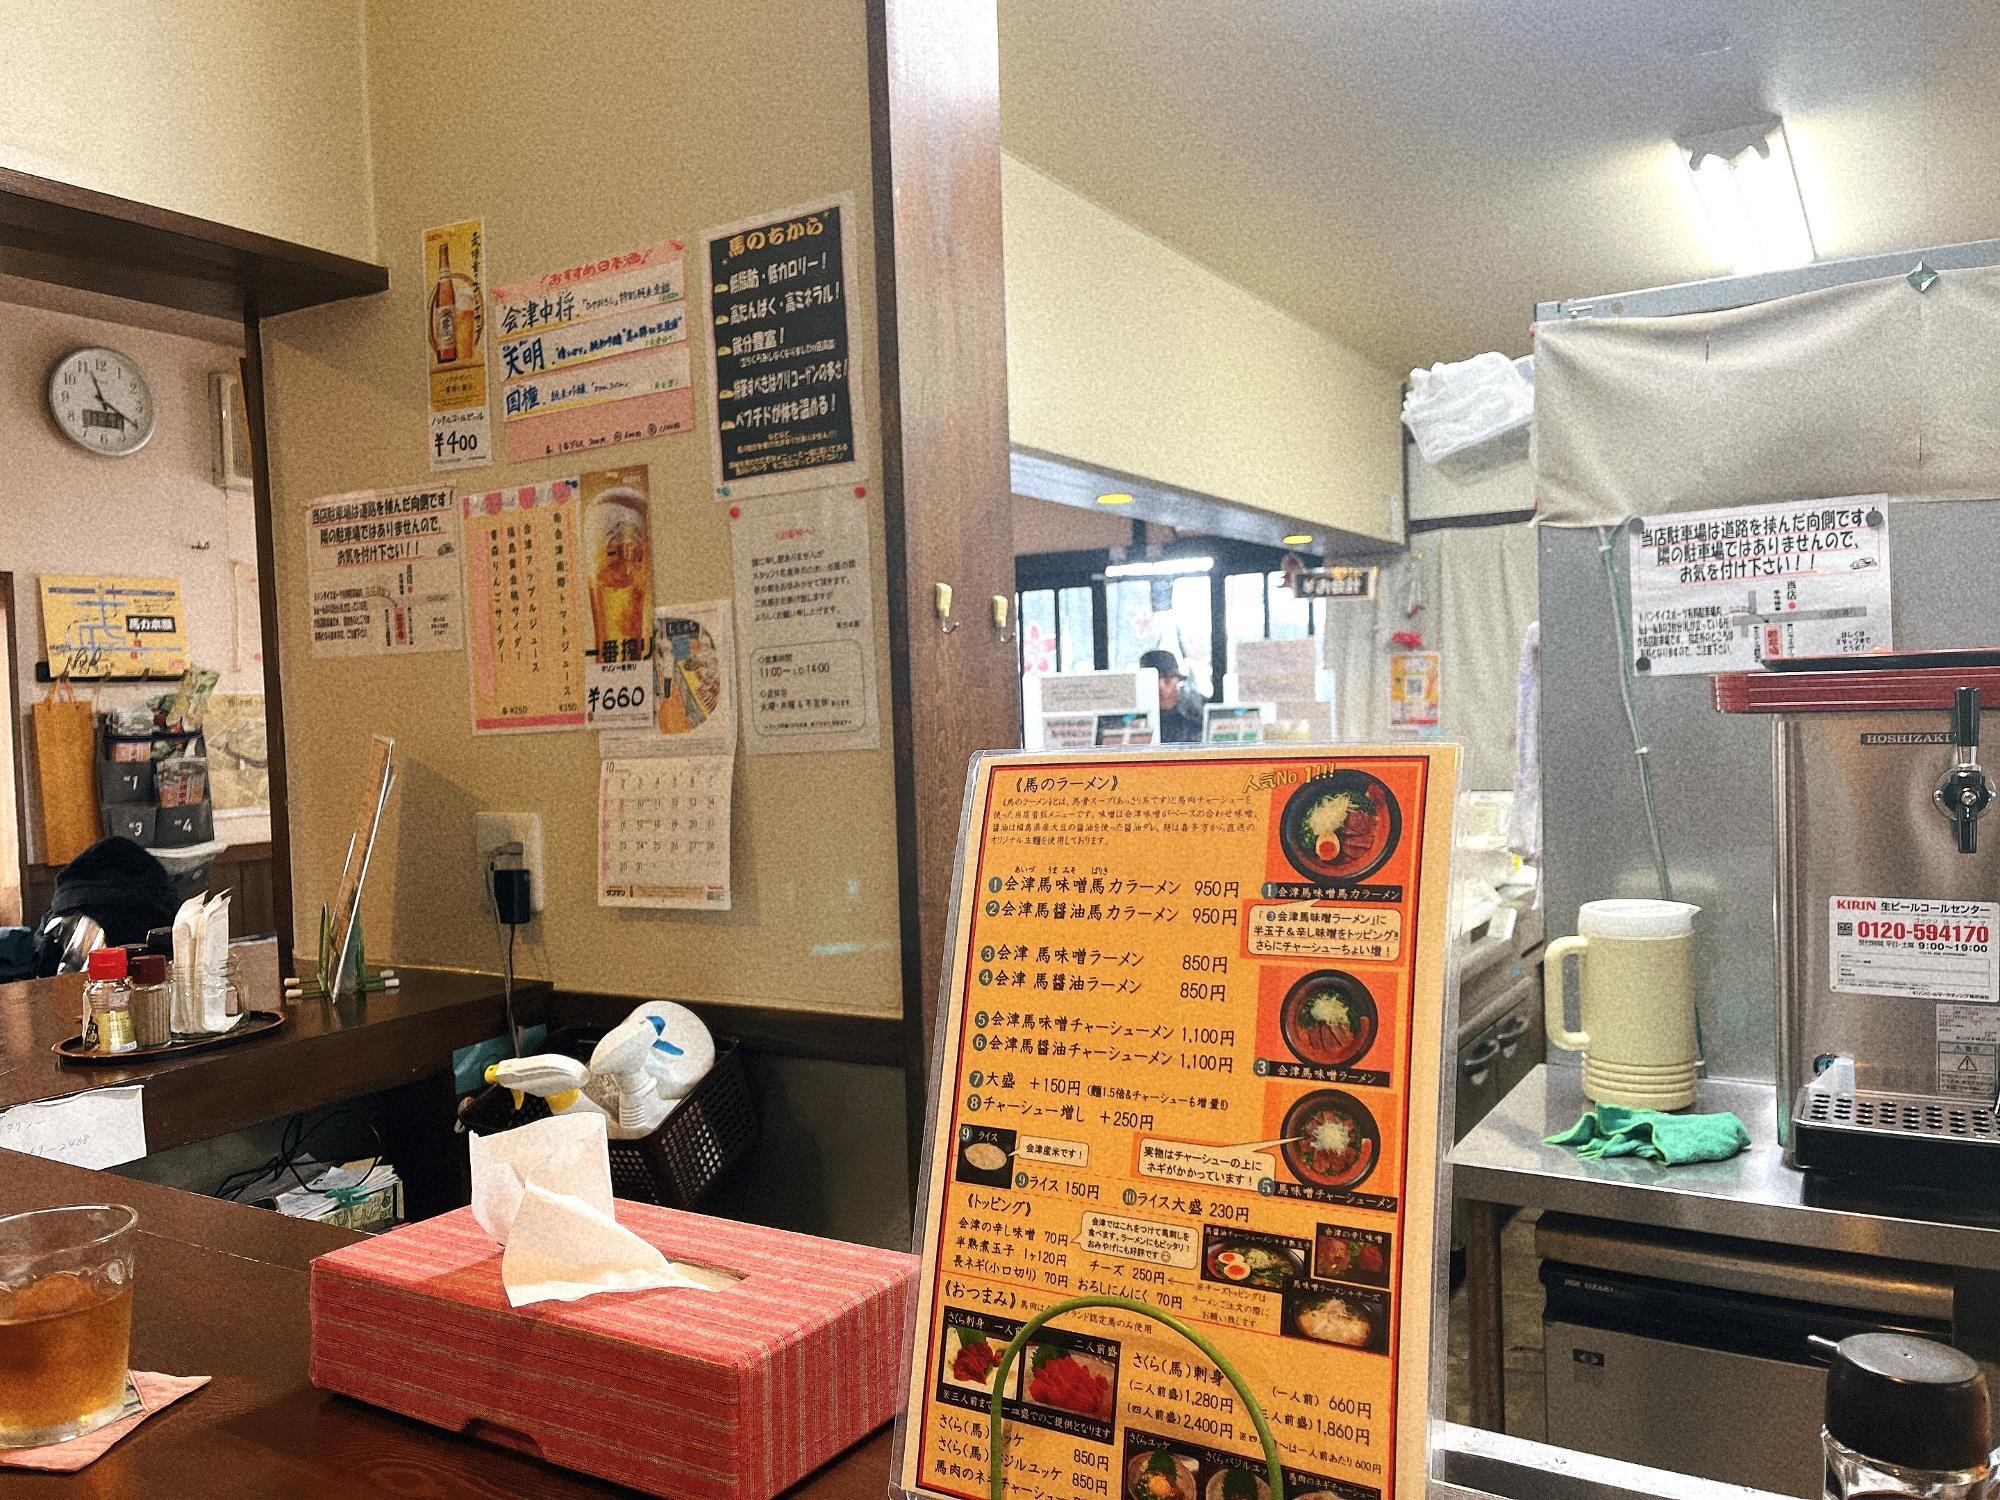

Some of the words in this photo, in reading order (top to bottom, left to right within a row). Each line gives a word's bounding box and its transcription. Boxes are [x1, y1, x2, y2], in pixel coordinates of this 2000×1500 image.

[728, 217, 824, 258] 馬のちから
[502, 290, 574, 333] 会津中将
[503, 337, 544, 381] 天明
[435, 430, 477, 456] ¥400
[1680, 554, 1816, 583] お気を付け下さい！！
[588, 686, 645, 712] ¥660
[1016, 775, 1119, 793] 《馬のラーメン》
[1194, 880, 1240, 899] 950円
[1192, 908, 1238, 927] 950円
[1837, 900, 1876, 911] KIRIN
[1881, 902, 1990, 914] 生ビールコールセンター
[1858, 921, 1989, 943] 0120-594170
[1182, 955, 1228, 974] 850円
[1180, 983, 1226, 1002] 850円
[1181, 1026, 1235, 1048] 1,100円
[1180, 1053, 1233, 1074] 1,100円
[985, 1071, 1015, 1089] 大盛
[983, 1096, 1085, 1122] チャーシュー増し
[977, 1131, 998, 1142] ライス
[1026, 1143, 1083, 1160] 会津産米です！
[1143, 1146, 1262, 1171] 実物はチャーシューの上に
[1147, 1162, 1253, 1186] ネギがかかっています！
[967, 1193, 1032, 1217] 《トッピング》
[1029, 1176, 1059, 1193] ライス
[1065, 1181, 1100, 1200] 150円
[1137, 1192, 1203, 1216] ライス大盛
[1209, 1202, 1249, 1223] 230円
[958, 1216, 1036, 1241] 会津の辛し味噌
[1044, 1231, 1068, 1248] 70円
[955, 1235, 1015, 1258] 半熟煮玉子
[1088, 1240, 1159, 1260] おみやげにも好評です
[953, 1254, 1037, 1282] 長ネギ(小口切り)
[1044, 1271, 1069, 1289] 70円
[1089, 1260, 1124, 1277] チーズ
[1132, 1266, 1165, 1285] 250円
[944, 1279, 1017, 1310] 《おつまみ》
[1077, 1277, 1148, 1303] おろしにんにく
[1156, 1291, 1183, 1310] 70円
[948, 1313, 985, 1331] さくら刺身
[1202, 1310, 1257, 1327] お願い致します
[1074, 1340, 1119, 1359] 二人前盛
[1133, 1351, 1225, 1387] さくら(馬)刺身
[1129, 1379, 1183, 1402] (二人前盛)
[1184, 1388, 1234, 1415] 1,280円
[1272, 1386, 1320, 1407] (一人前)
[1328, 1395, 1372, 1419] 660円
[1127, 1402, 1181, 1425] (四人前盛)
[1183, 1414, 1233, 1441] 2,400円
[1316, 1416, 1370, 1447] 1,860円
[939, 1413, 1025, 1446] さくら(馬)ッケ
[1073, 1448, 1109, 1472] 850円
[1129, 1431, 1171, 1450] さくらユッケ
[1204, 1450, 1268, 1476] さくらバジルユッ
[1355, 1459, 1382, 1475] 600円
[1072, 1472, 1108, 1497] 850円
